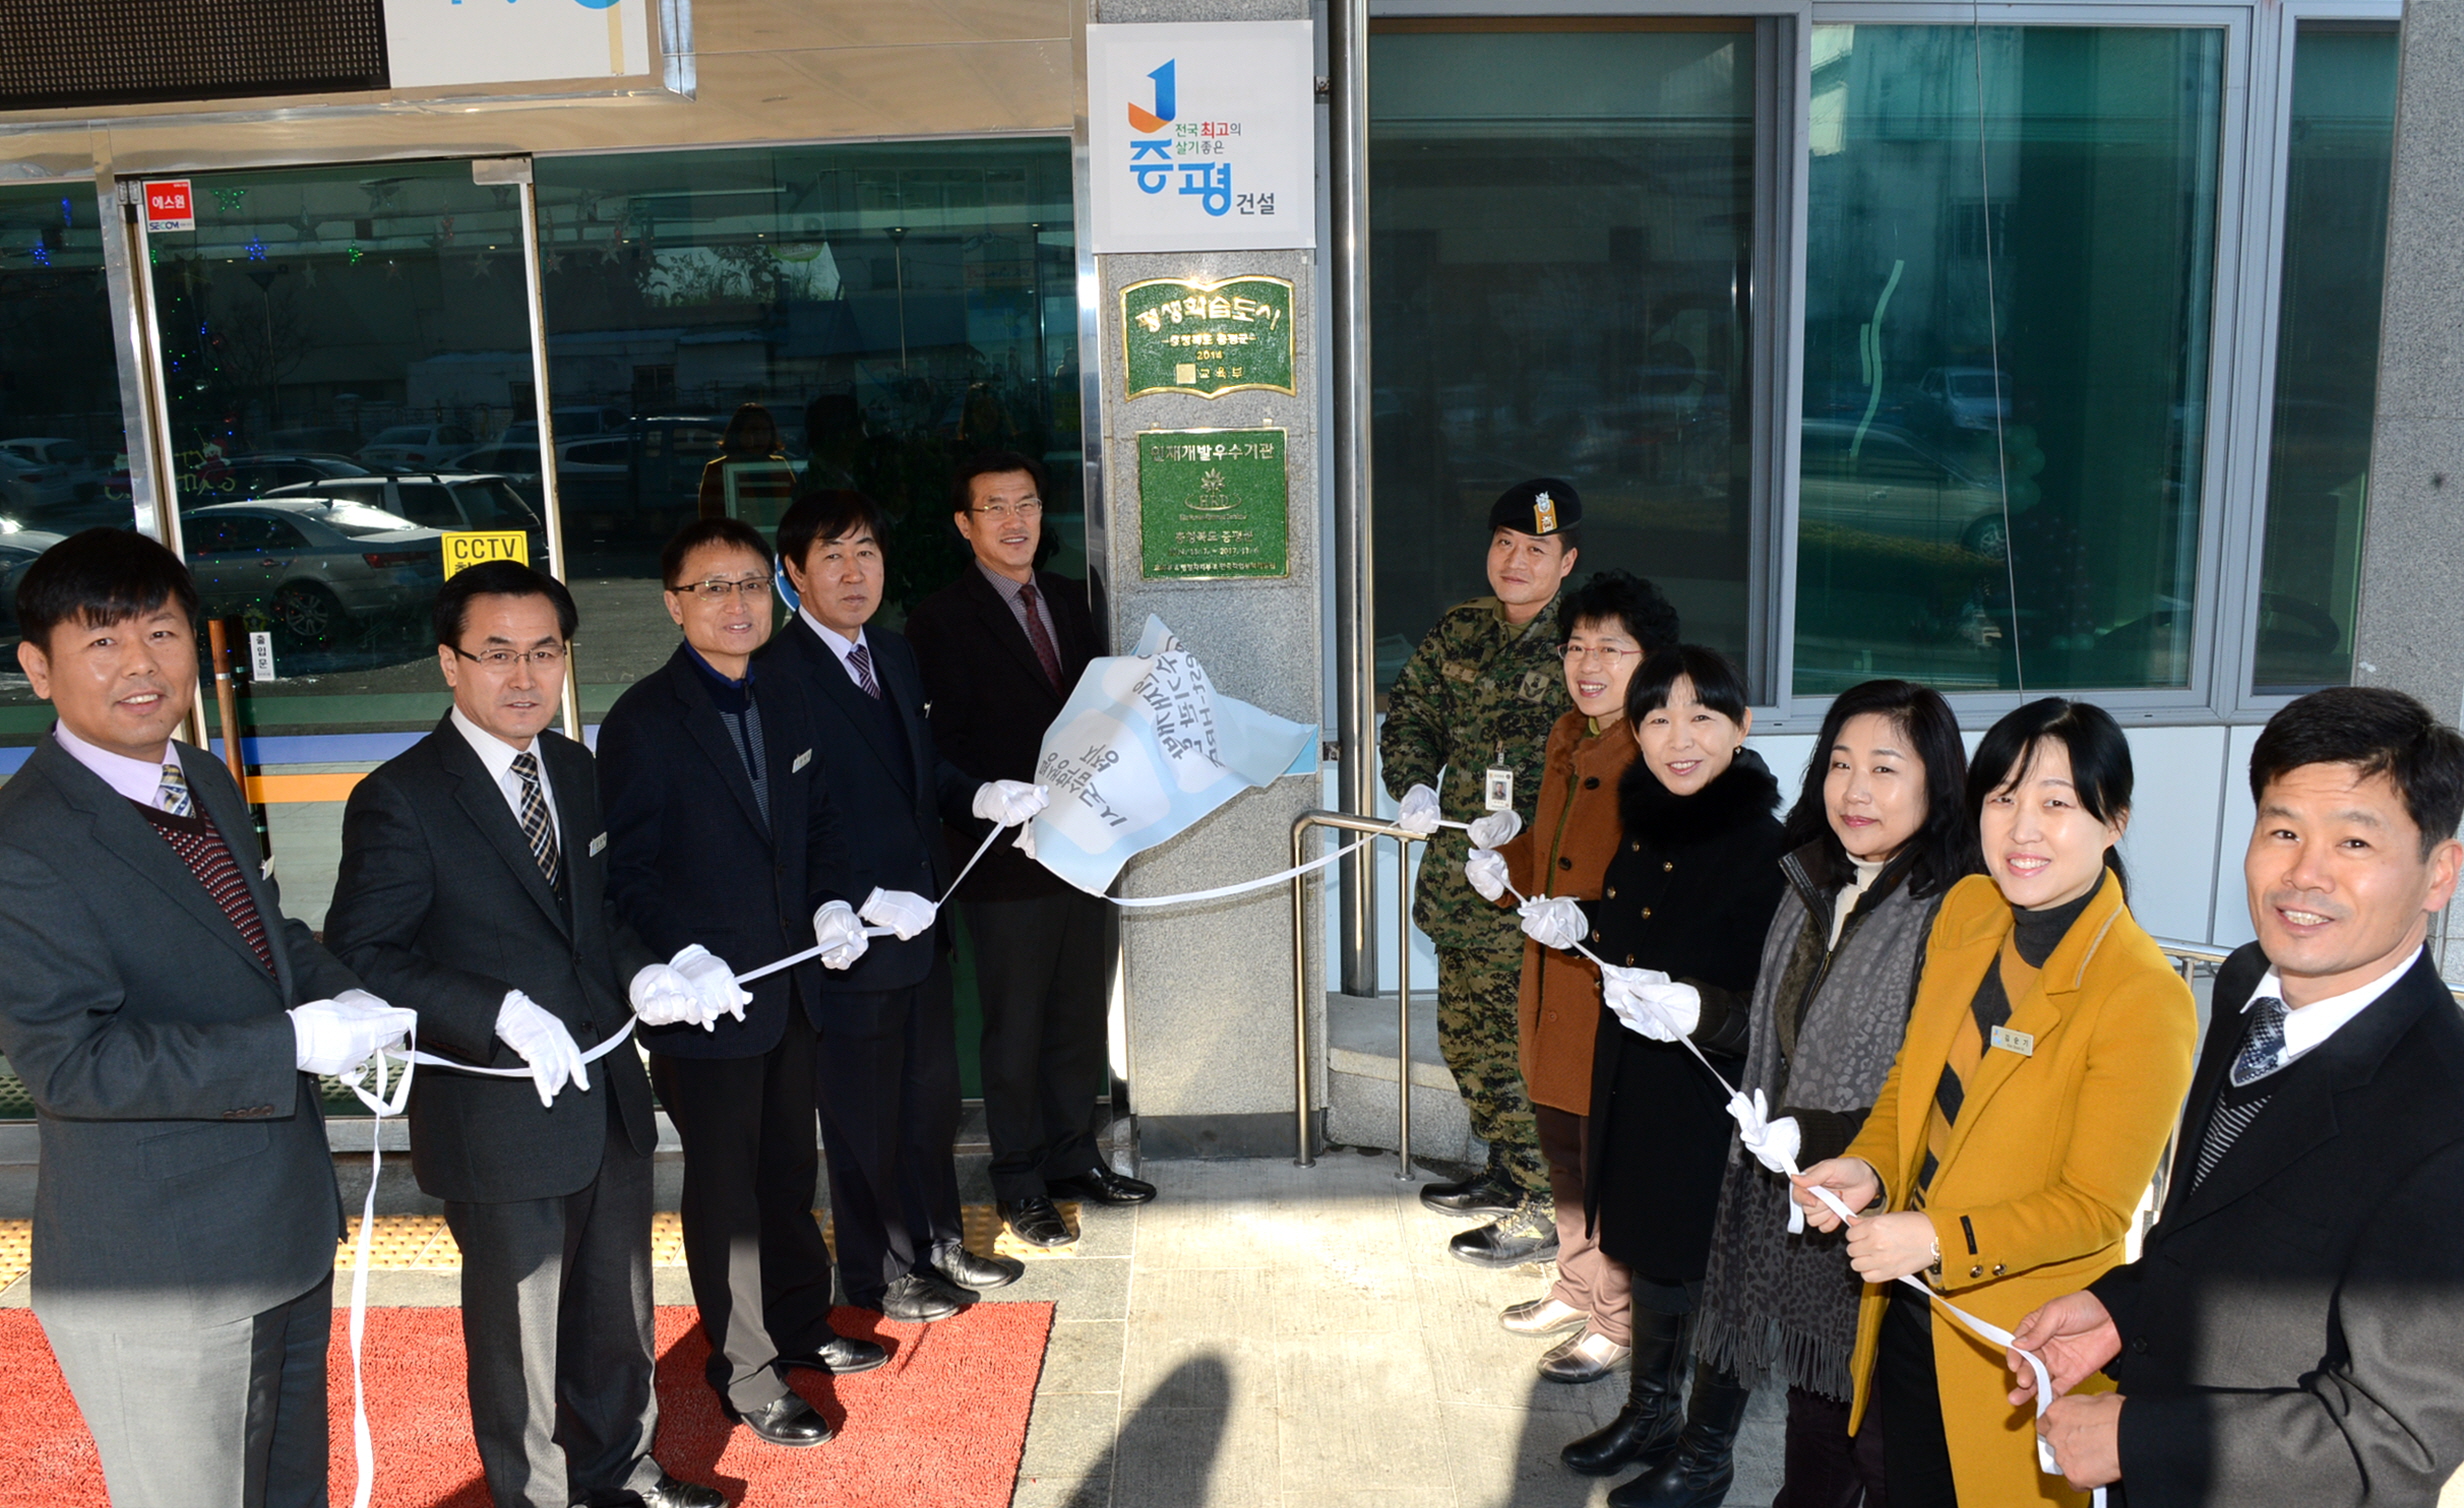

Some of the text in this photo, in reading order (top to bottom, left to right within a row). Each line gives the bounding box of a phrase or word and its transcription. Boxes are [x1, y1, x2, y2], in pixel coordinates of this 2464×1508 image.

[1175, 121, 1242, 139] 전국 최고의
[1129, 138, 1276, 217] 증평 건설
[152, 194, 186, 210] 에스원
[149, 221, 180, 230] SECOM
[1135, 294, 1281, 333] 평생학습도시
[1196, 350, 1224, 360] 2014
[1150, 442, 1275, 463] 인재개발우수기관
[1199, 494, 1229, 507] HRD
[454, 538, 516, 559] CCTV
